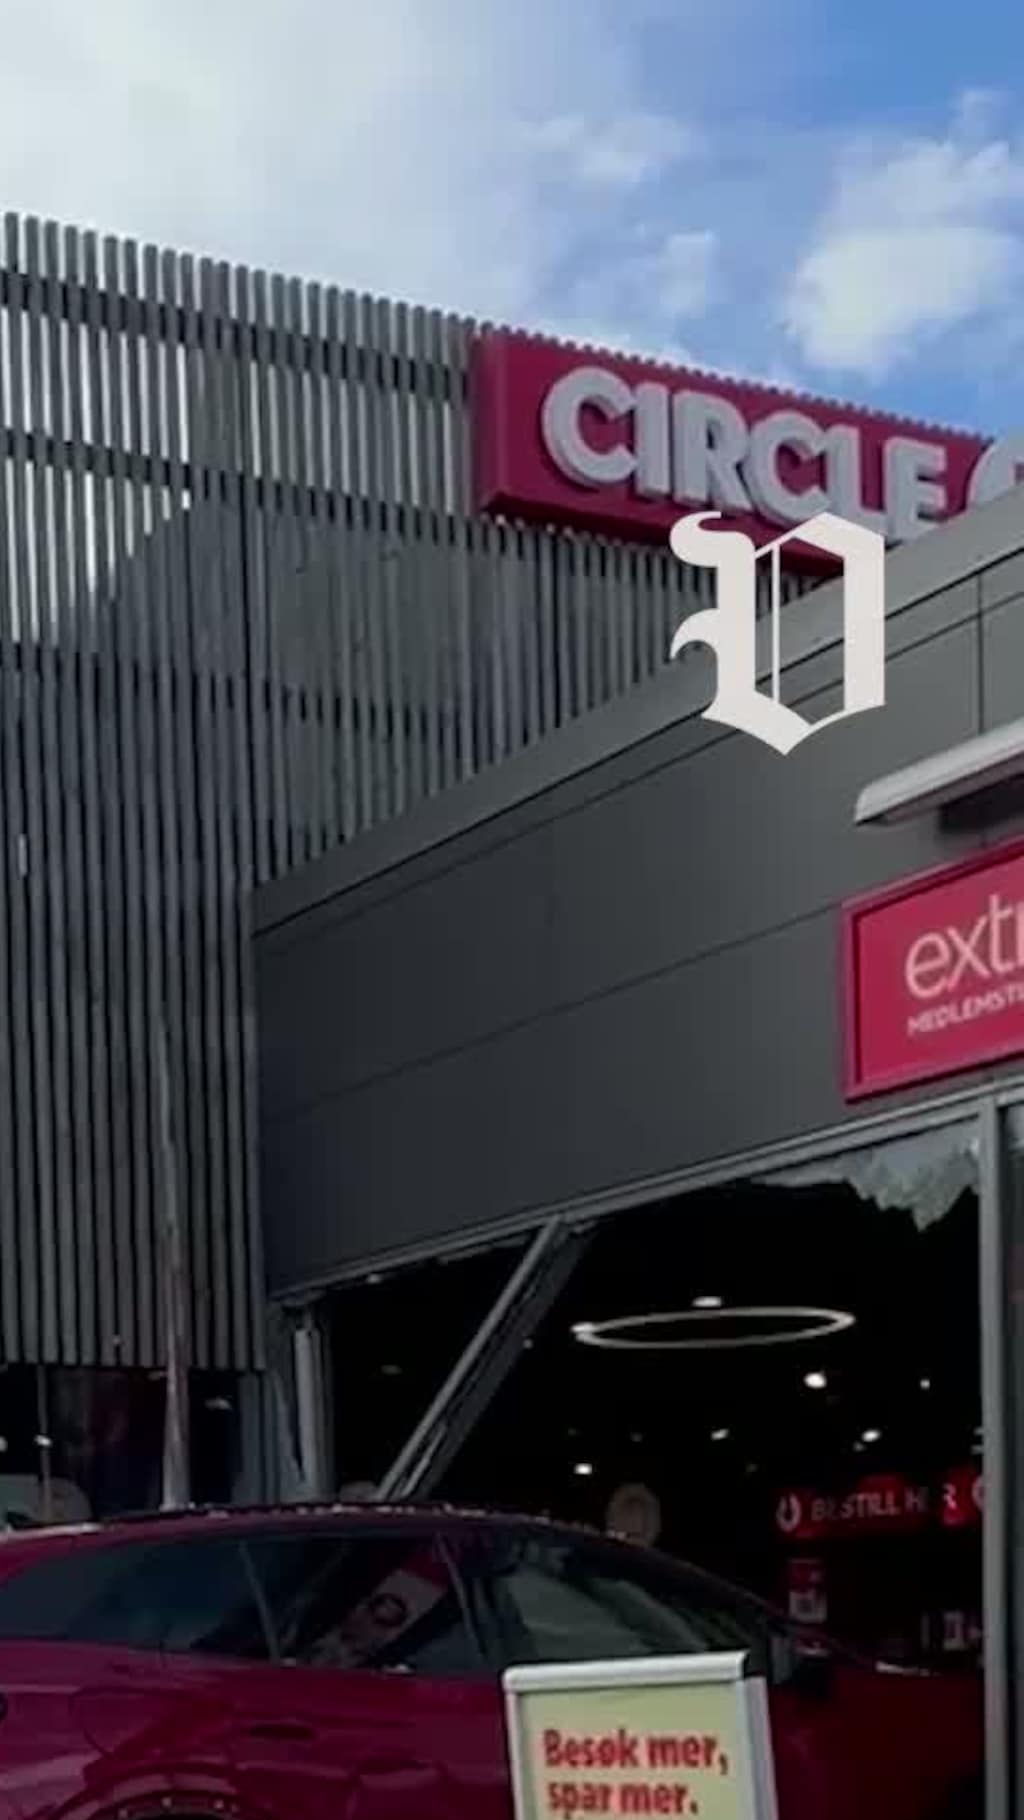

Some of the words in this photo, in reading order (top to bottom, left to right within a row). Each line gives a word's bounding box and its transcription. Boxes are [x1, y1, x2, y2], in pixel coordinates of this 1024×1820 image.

[541, 366, 948, 545] CIRCLE
[646, 1735, 729, 1775] mer,
[548, 1782, 611, 1820] spar
[619, 1783, 699, 1815] mer.
